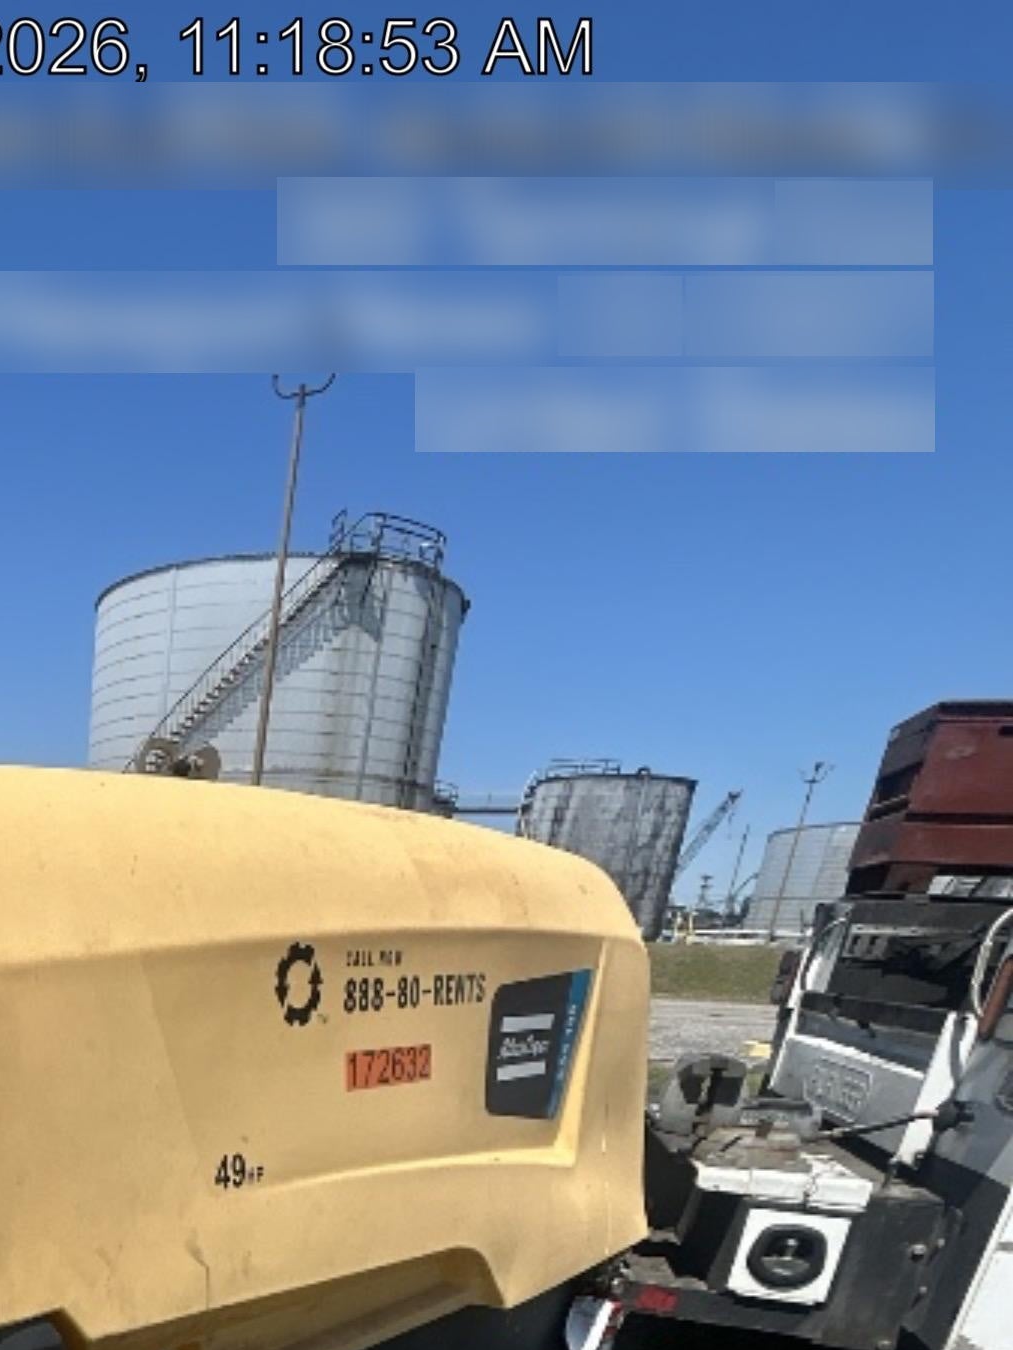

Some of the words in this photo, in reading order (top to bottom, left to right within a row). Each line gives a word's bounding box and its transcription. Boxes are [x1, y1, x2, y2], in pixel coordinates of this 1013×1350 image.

[343, 974, 486, 1013] 888-80-RENTS
[348, 1046, 430, 1087] 172632
[214, 1153, 246, 1189] 49
